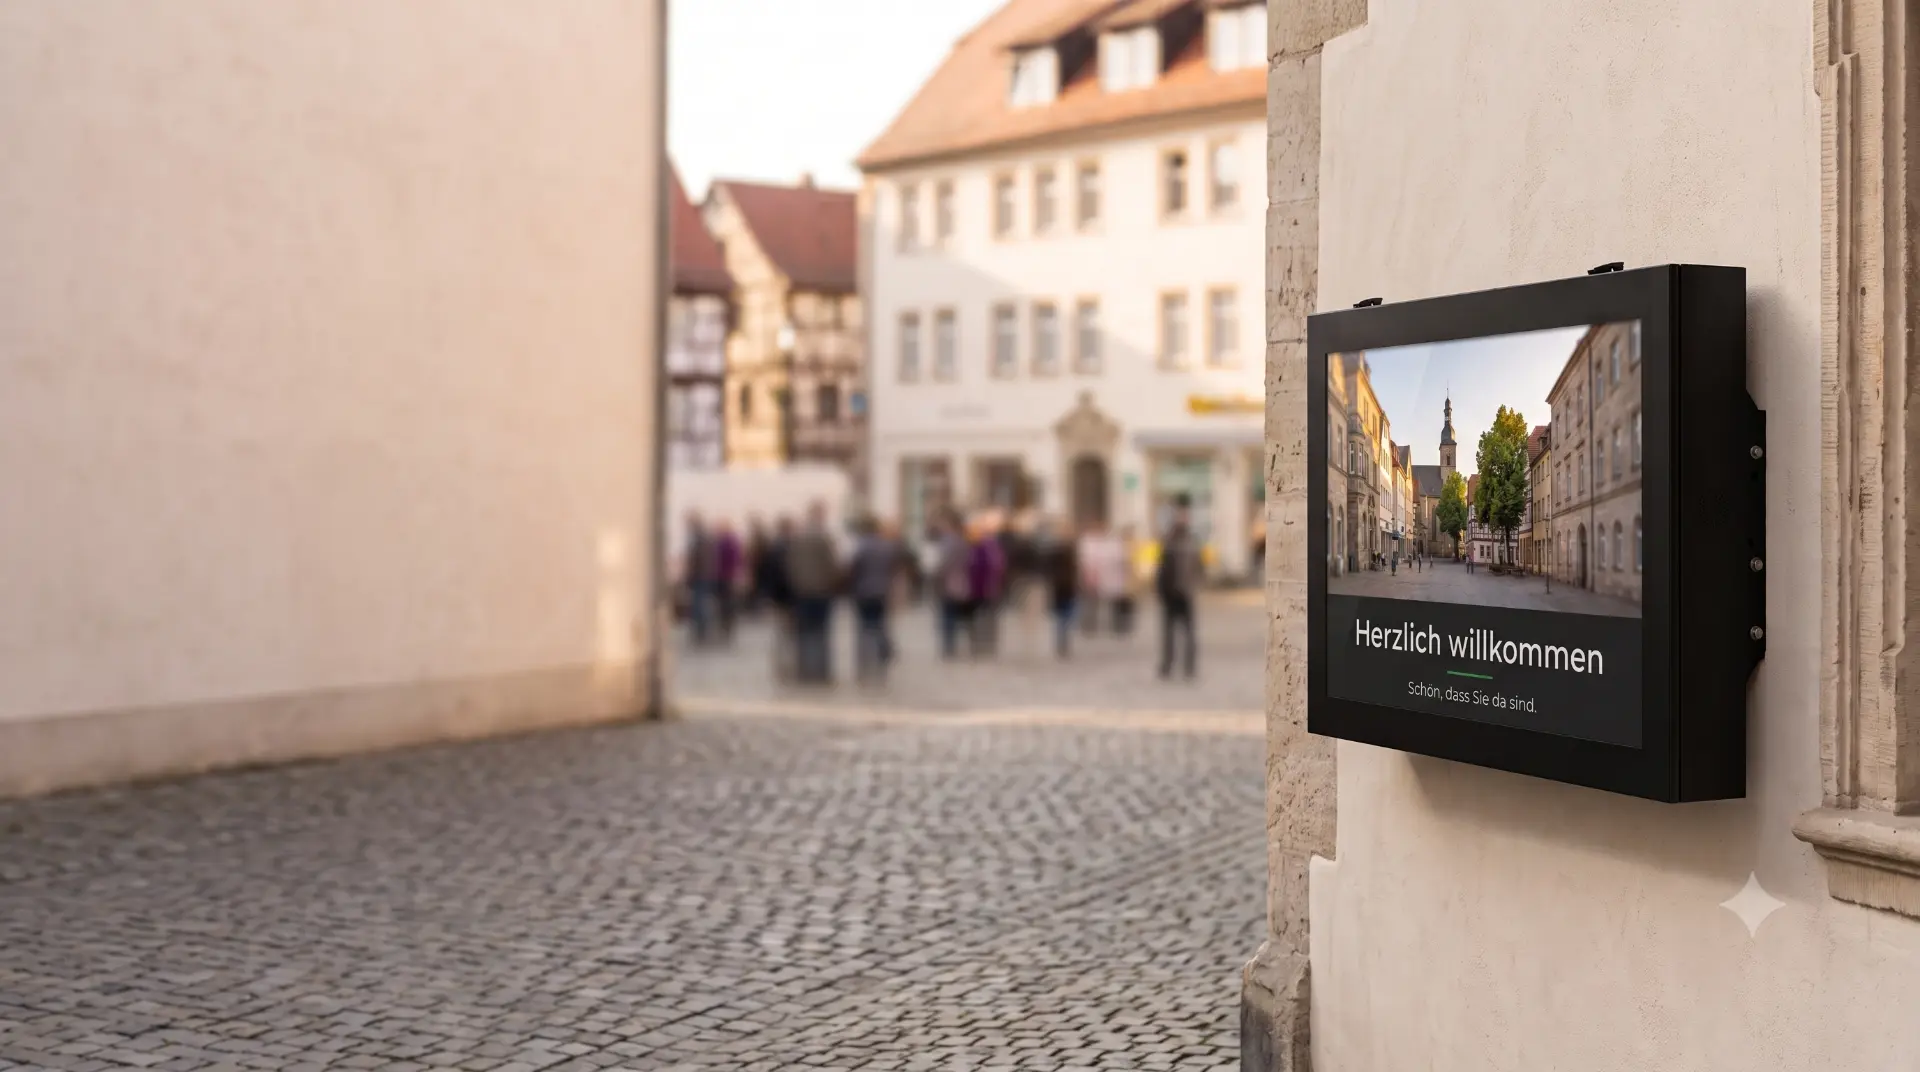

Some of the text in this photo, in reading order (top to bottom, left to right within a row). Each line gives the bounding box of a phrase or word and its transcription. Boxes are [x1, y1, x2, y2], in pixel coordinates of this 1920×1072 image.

[1355, 618, 1604, 675] Herzlich willkommen
[1408, 681, 1537, 713] Schön, dass Sie da sind.
